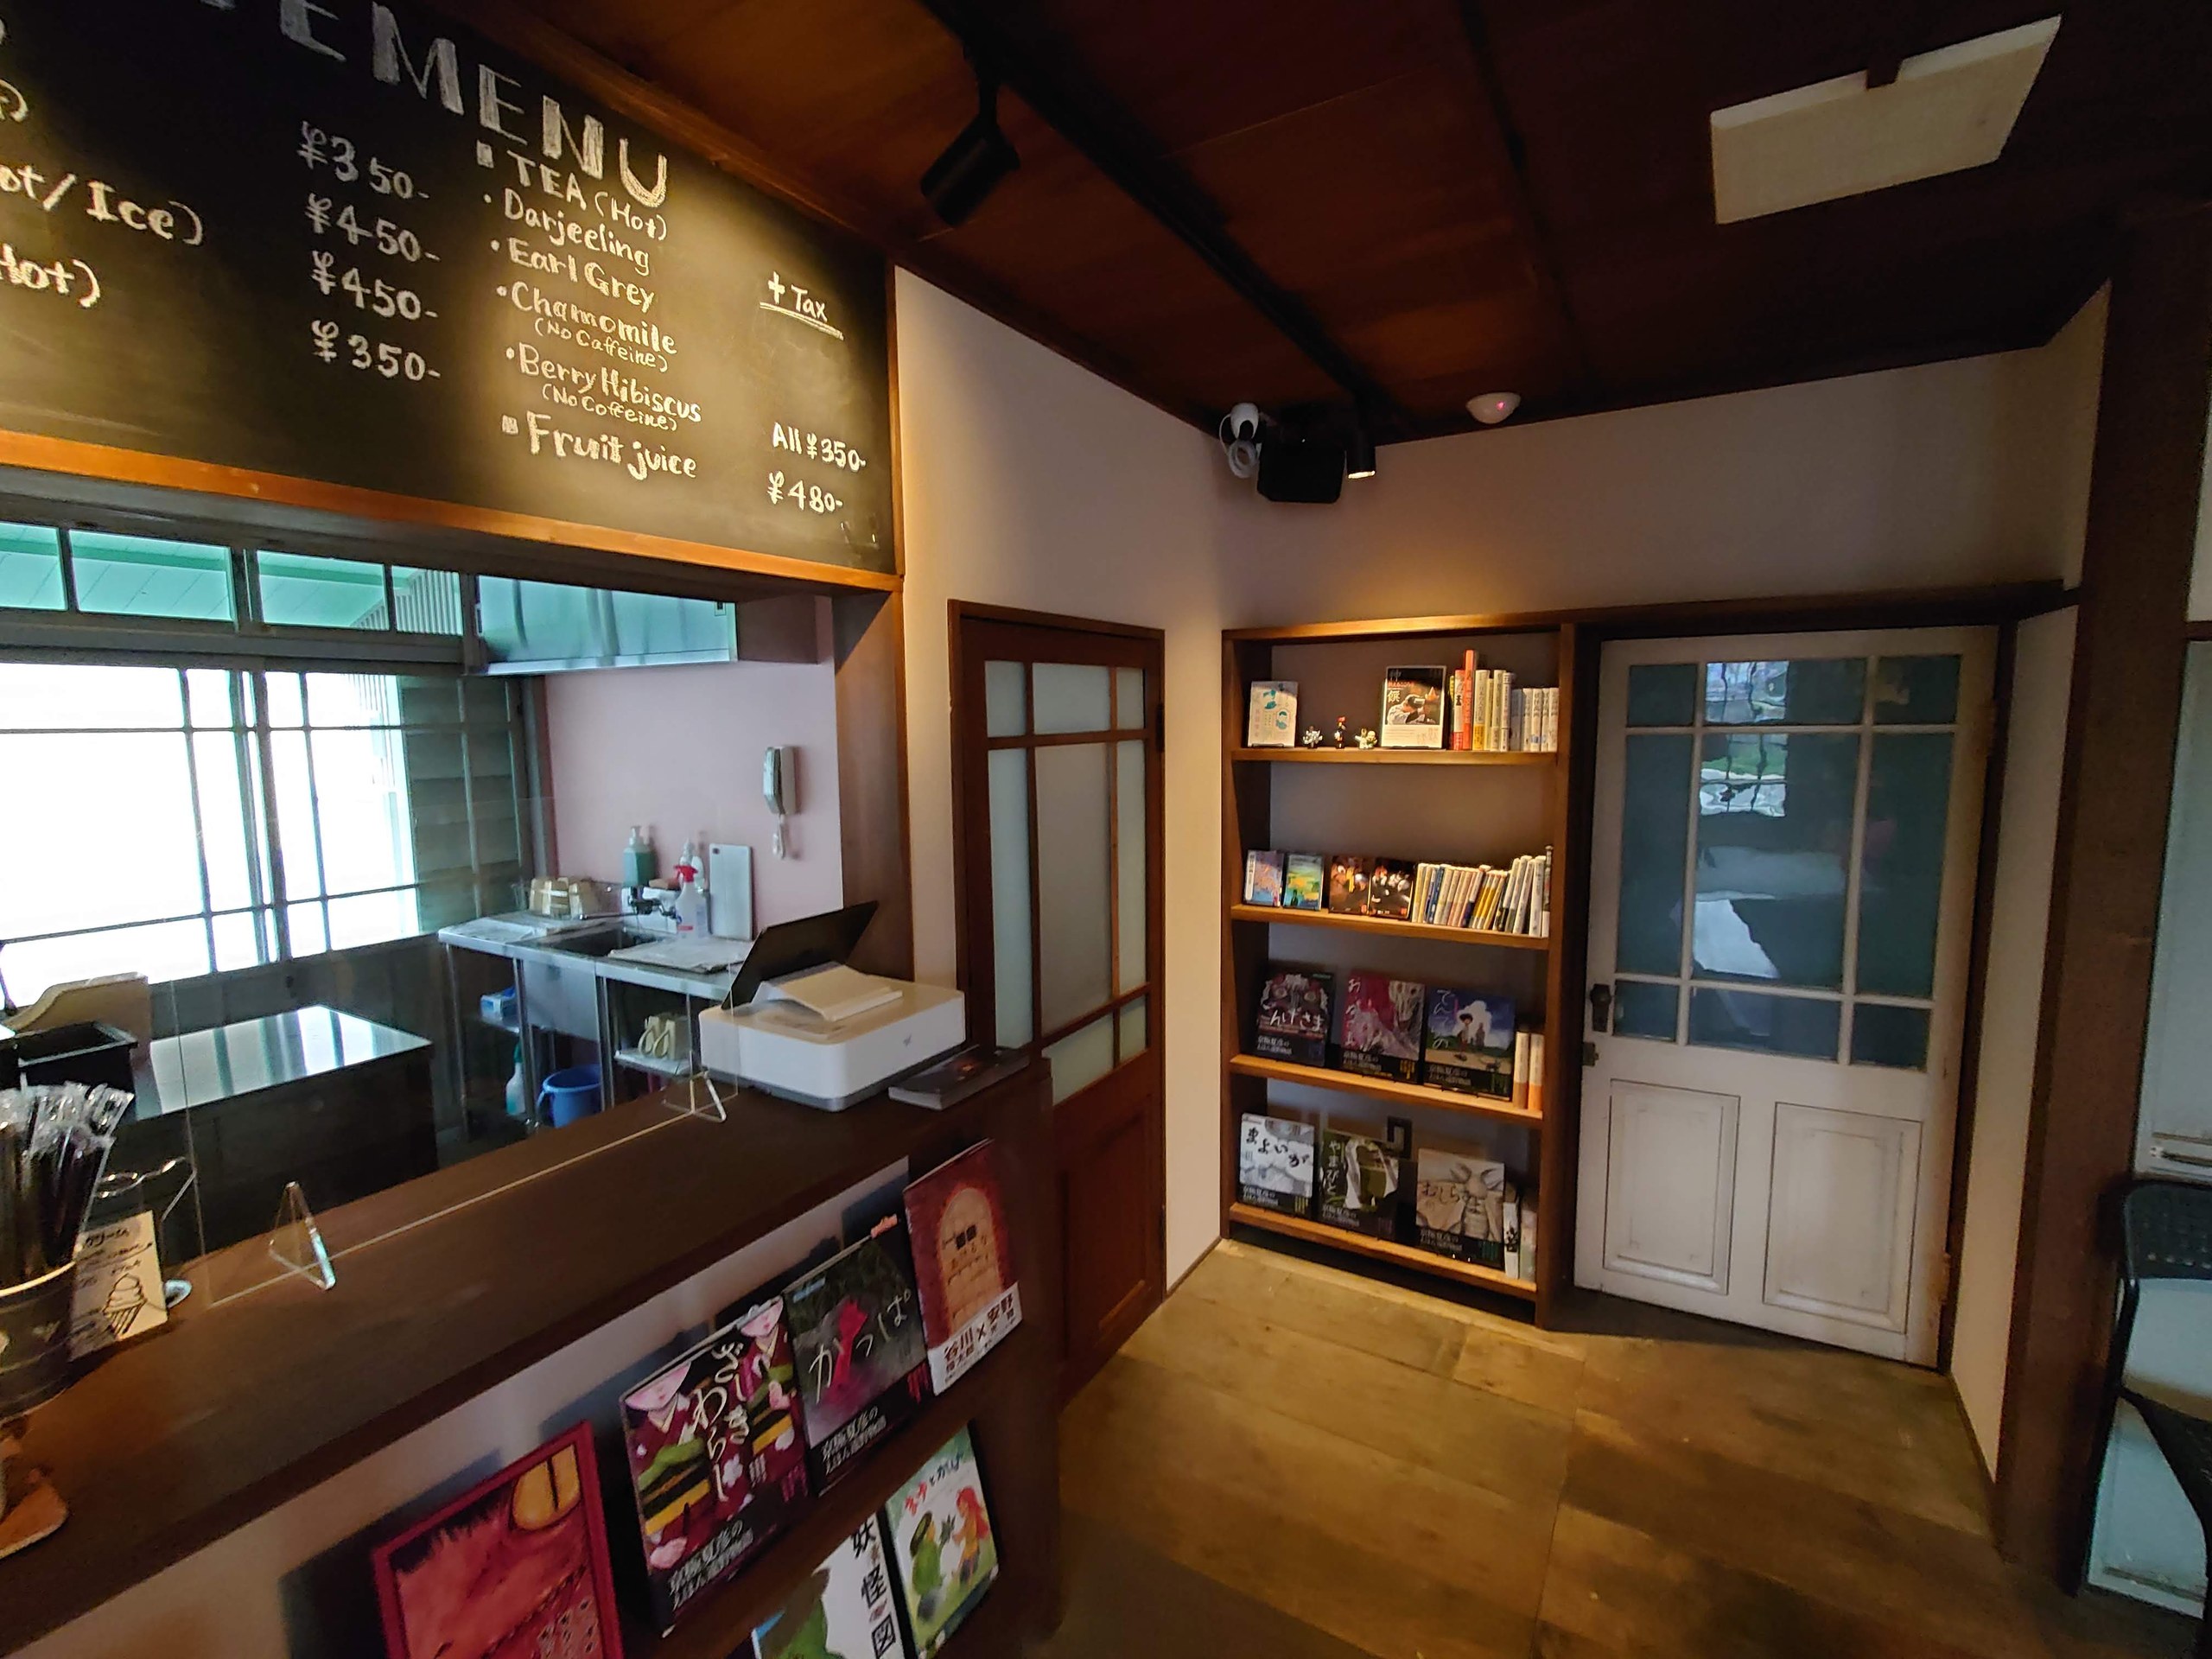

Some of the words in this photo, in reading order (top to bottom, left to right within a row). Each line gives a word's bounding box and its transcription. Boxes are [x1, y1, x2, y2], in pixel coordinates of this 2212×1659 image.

[372, 1, 668, 208] MENU
[507, 149, 587, 210] TEA
[594, 191, 667, 240] (Hot)
[505, 188, 649, 276] Darjeeling
[508, 237, 578, 283] Earl
[584, 262, 654, 313] Grey
[512, 281, 677, 354] Chamomile
[534, 317, 572, 340] (No
[575, 329, 668, 372] Caffeine)
[518, 341, 597, 393] Berry
[601, 366, 702, 423] Hibiscus
[543, 383, 577, 407] (No
[526, 410, 624, 465] Fruit
[627, 441, 696, 480] juice
[772, 422, 802, 454] All
[1246, 1127, 1309, 1167] まよいが
[808, 1288, 911, 1404] かっぱ
